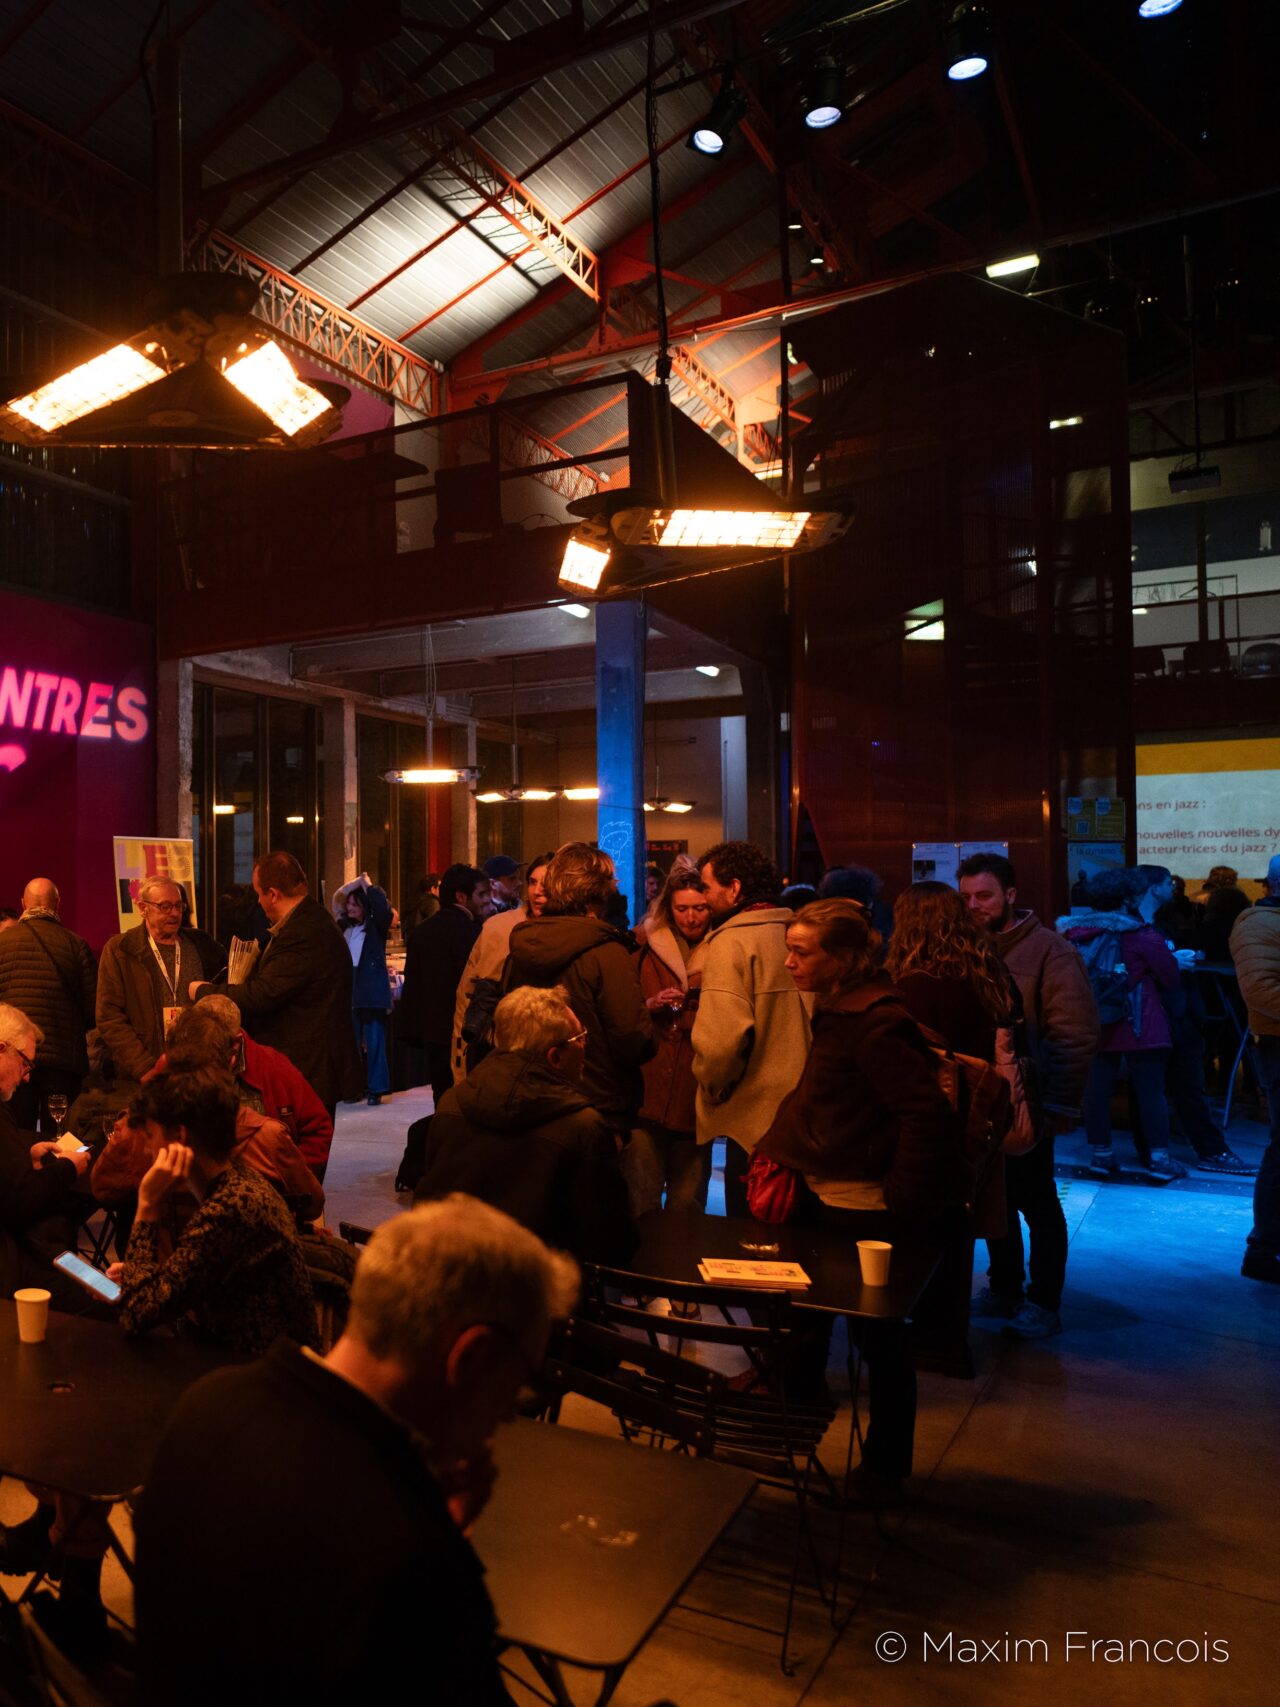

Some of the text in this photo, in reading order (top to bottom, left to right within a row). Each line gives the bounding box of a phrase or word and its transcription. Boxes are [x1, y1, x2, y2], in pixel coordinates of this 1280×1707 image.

[1156, 800, 1172, 810] en
[1174, 799, 1200, 812] jazz
[1136, 829, 1195, 840] nouvelles
[1198, 827, 1261, 839] nouvelles
[1221, 842, 1238, 854] du
[1241, 842, 1268, 856] jazz
